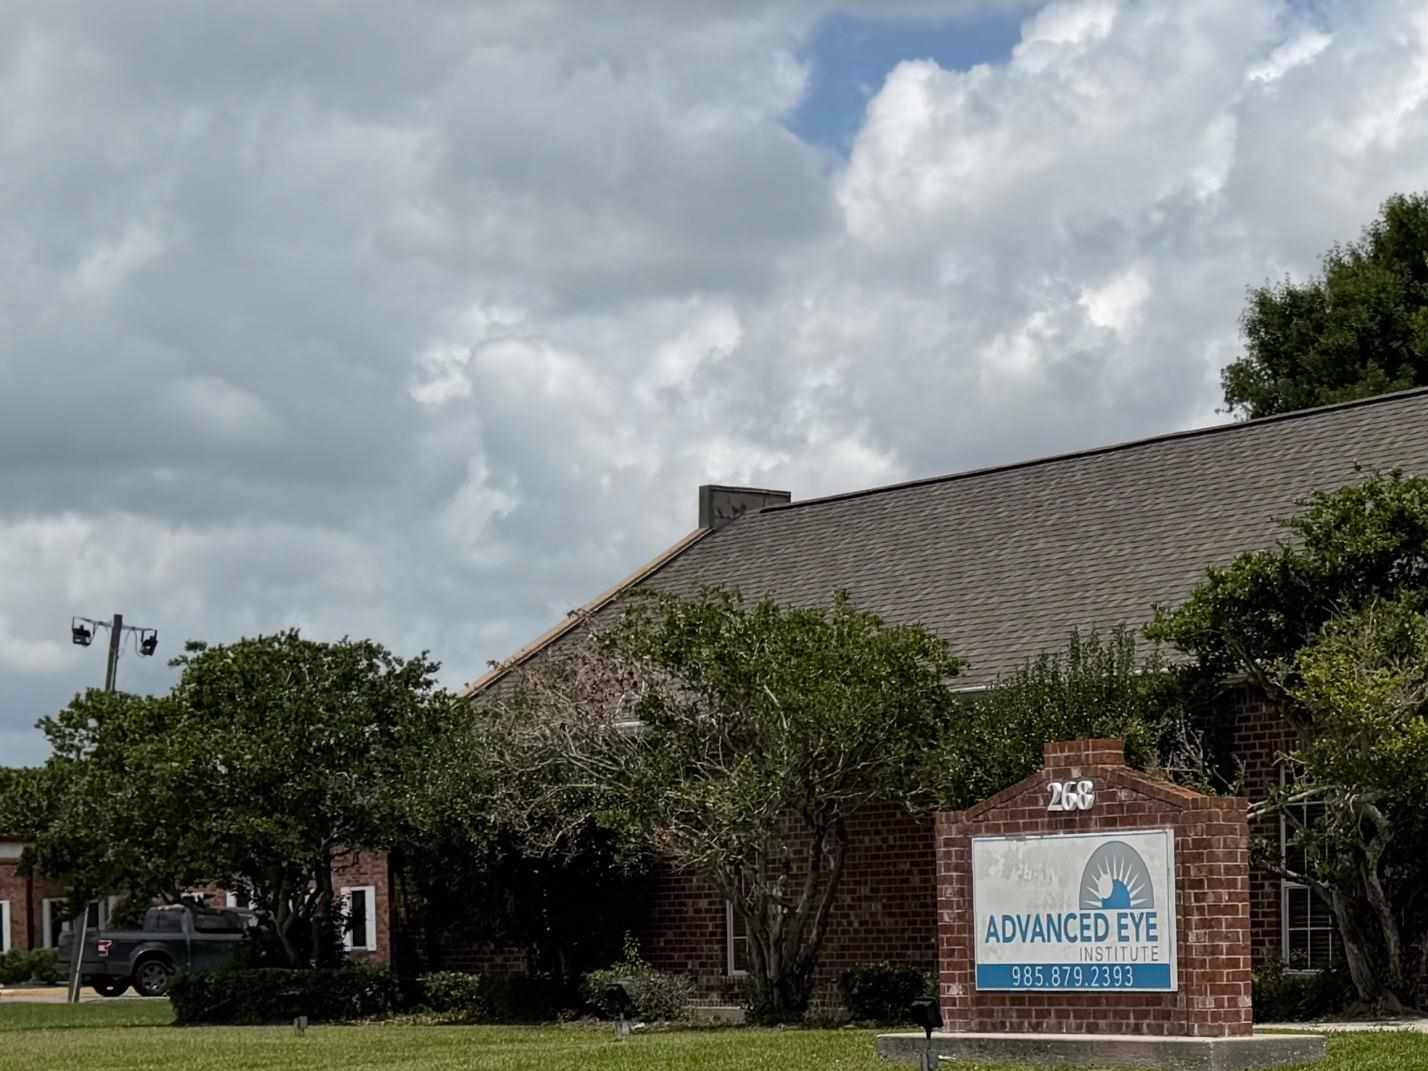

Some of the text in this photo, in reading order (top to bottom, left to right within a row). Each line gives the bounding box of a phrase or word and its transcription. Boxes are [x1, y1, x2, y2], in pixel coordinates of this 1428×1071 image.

[1047, 780, 1095, 811] 268
[985, 912, 1159, 943] ADVANCED EYE
[1079, 946, 1159, 962] INSTITUTE
[1012, 966, 1134, 987] 985.879.2393
